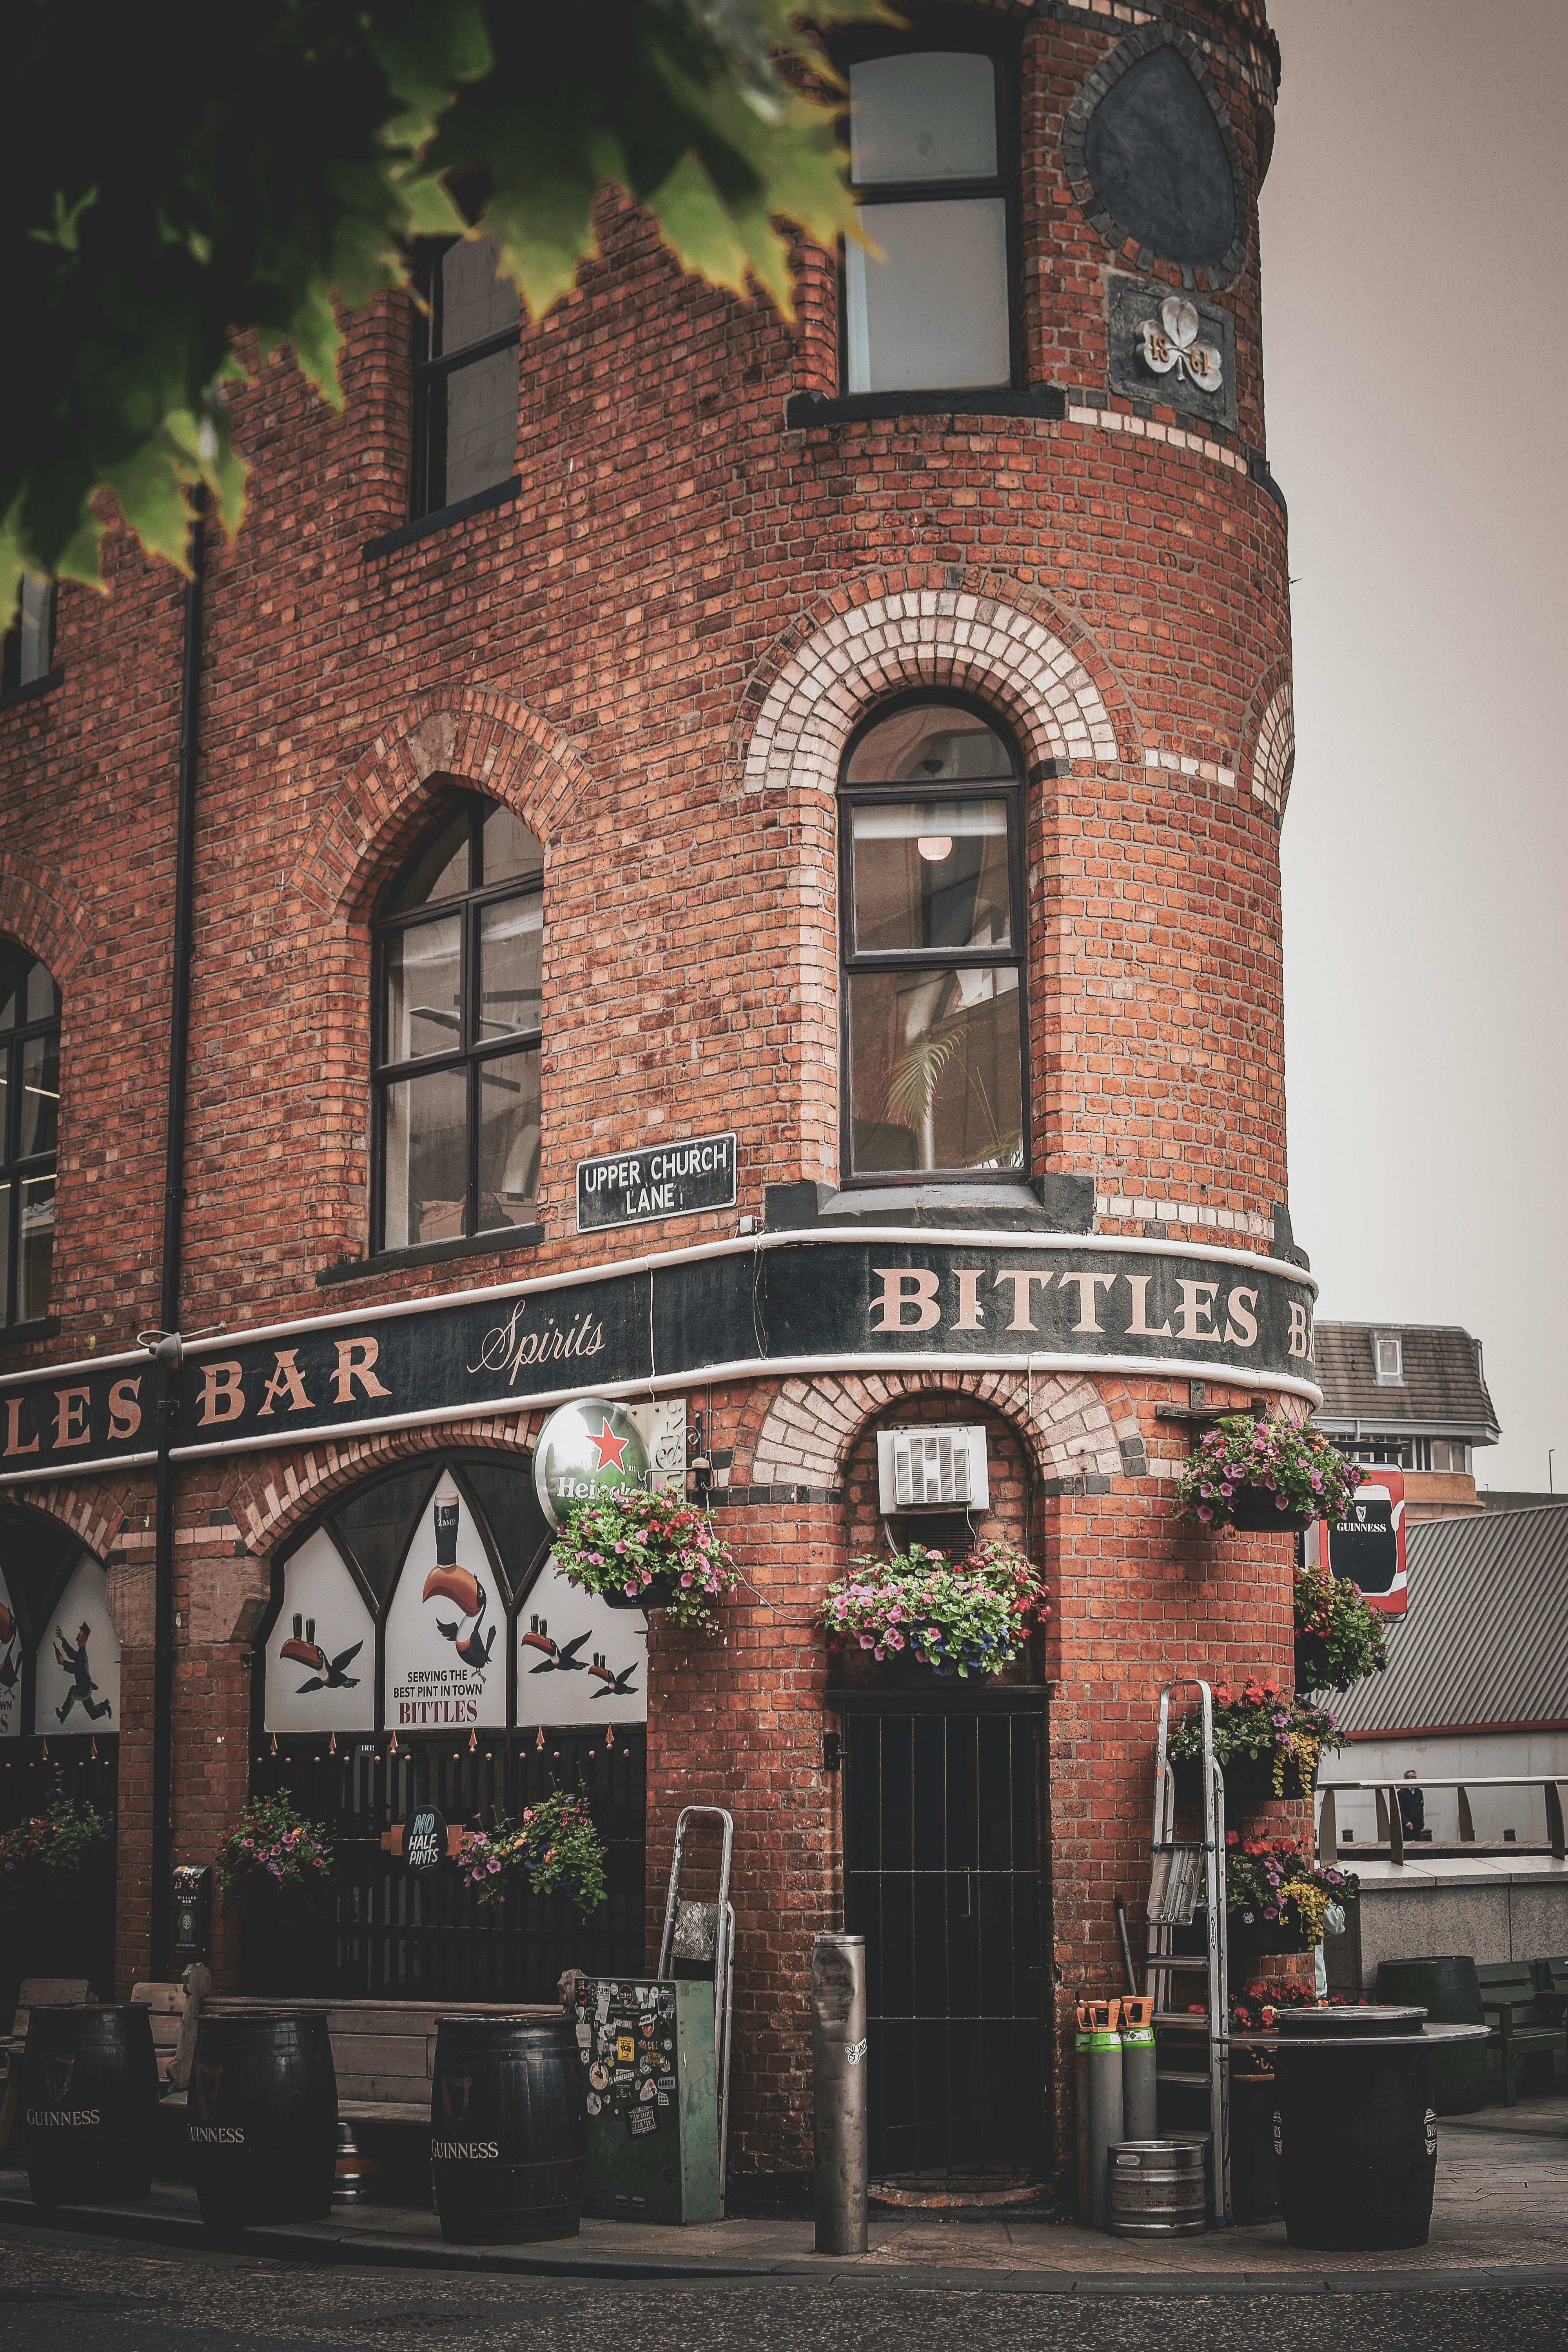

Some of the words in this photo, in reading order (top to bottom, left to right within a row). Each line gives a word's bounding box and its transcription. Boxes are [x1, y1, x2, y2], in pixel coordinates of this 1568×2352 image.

[1151, 334, 1169, 362] 18
[1191, 347, 1209, 376] 61
[584, 1161, 641, 1192] UPPER
[651, 1143, 727, 1180] CHURCH
[626, 1183, 675, 1215] LANE
[869, 1269, 1259, 1347] BITTLES
[467, 1300, 605, 1386] Spirits
[195, 1336, 392, 1426] BAR
[437, 1518, 456, 1526] GUINNESS
[1336, 1523, 1387, 1533] GUINNESS
[408, 1670, 448, 1682] SERVING
[449, 1669, 467, 1681] THE
[394, 1687, 416, 1698] BEST
[417, 1686, 438, 1697] PINT
[441, 1685, 450, 1697] IN
[452, 1684, 482, 1696] TOWN
[399, 1700, 477, 1724] BITTLES
[413, 1813, 435, 1835] NO
[408, 1833, 437, 1850] HALF
[409, 1848, 439, 1865] PINTS
[27, 2109, 100, 2126] GUINNESS
[629, 2110, 653, 2123] WERDER
[632, 2118, 655, 2131] BREMEN
[187, 2123, 244, 2143] GUINNESS
[432, 2139, 498, 2158] GUINNESS
